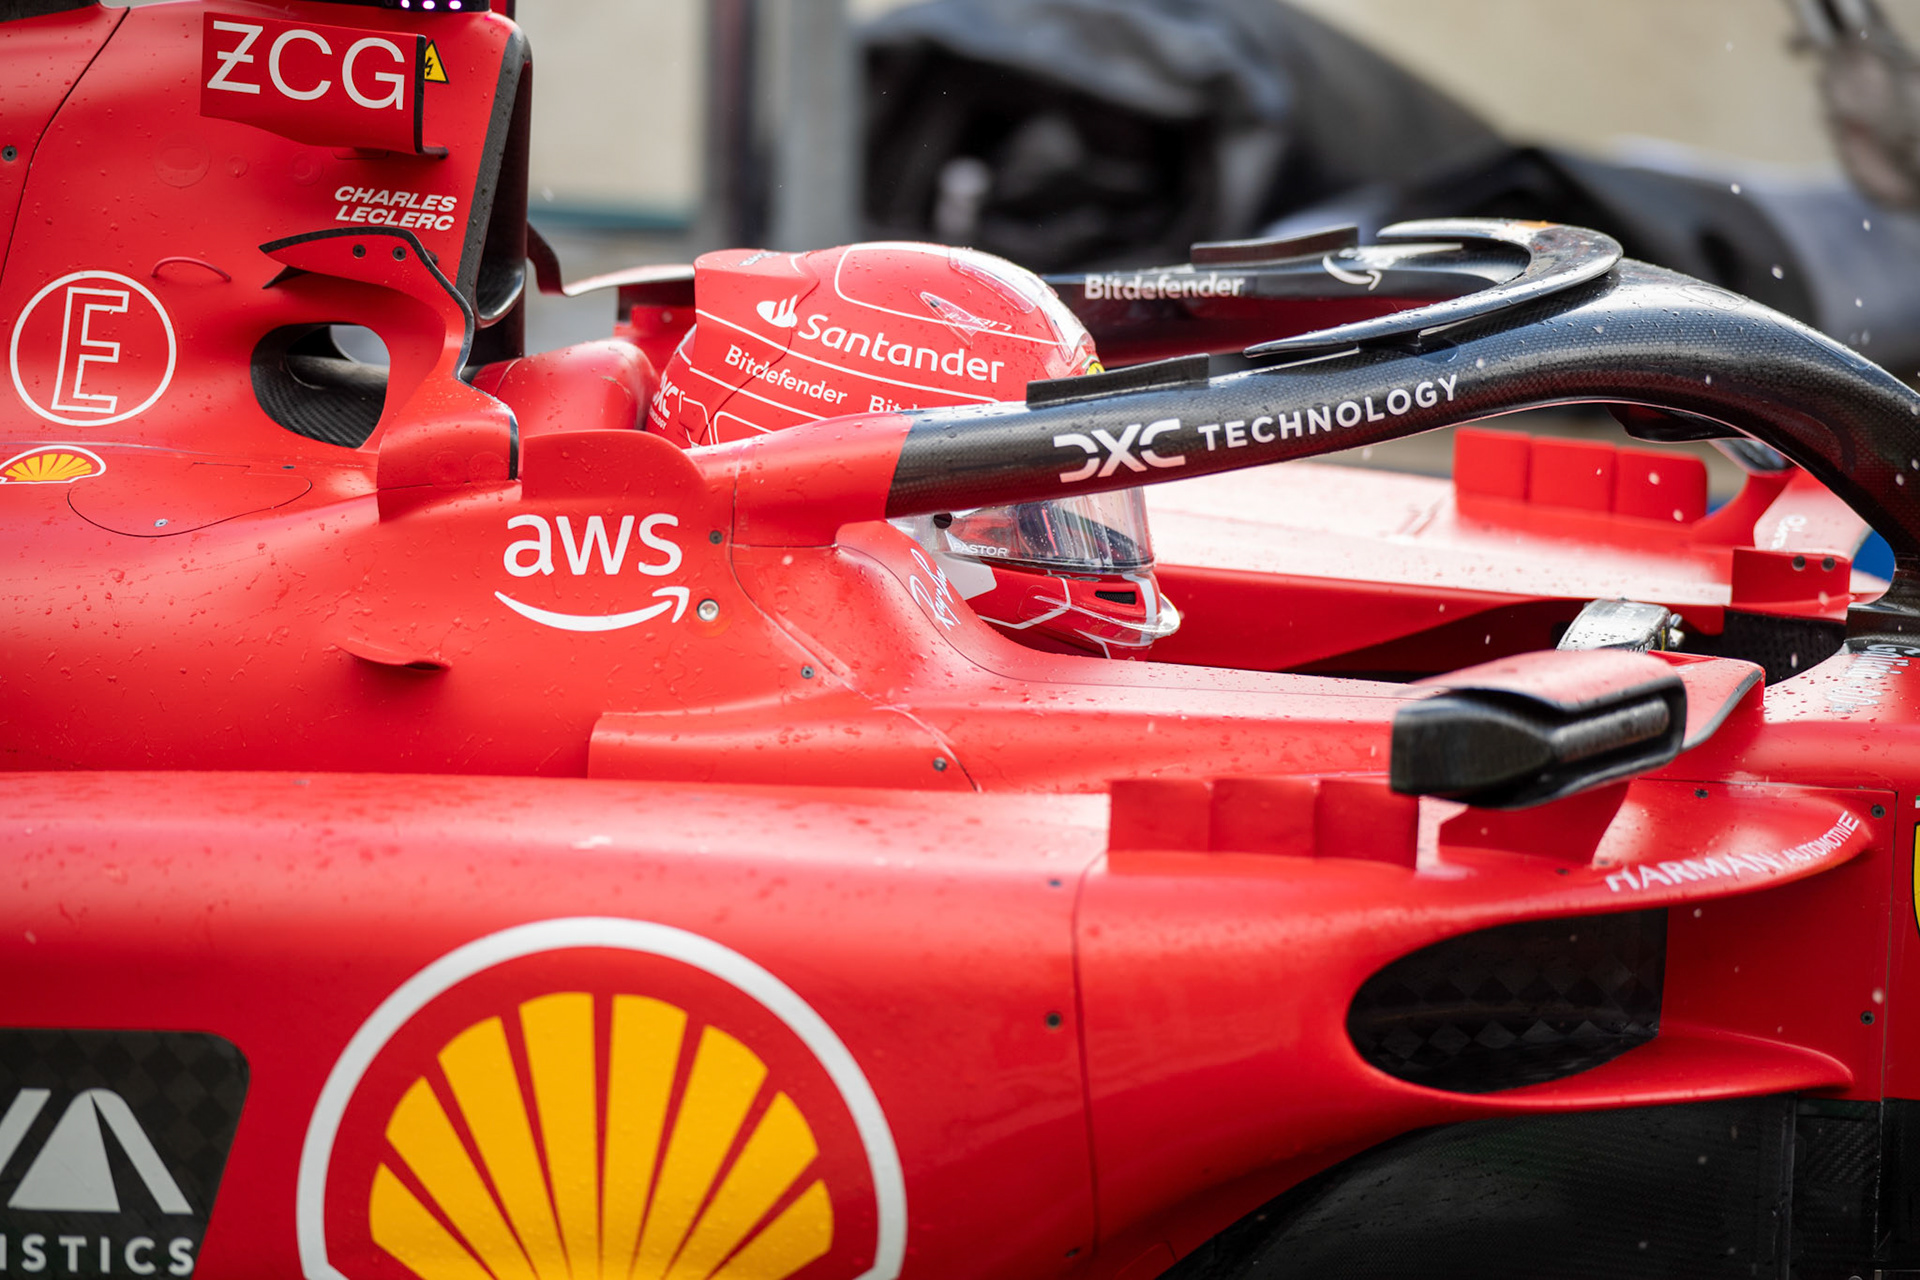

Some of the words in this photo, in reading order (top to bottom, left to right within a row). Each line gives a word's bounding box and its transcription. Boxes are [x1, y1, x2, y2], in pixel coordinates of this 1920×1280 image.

[334, 185, 458, 212] CHARLES
[335, 205, 455, 231] LECLERC
[1084, 271, 1245, 300] Bitdefender
[724, 344, 848, 405] Bitdefender
[797, 313, 1005, 384] Santander
[1053, 417, 1186, 483] DXC
[1197, 374, 1458, 451] TECHNOLOGY
[503, 513, 683, 577] aws
[1604, 852, 1783, 893] HARMAN
[1780, 810, 1860, 864] AUTOMOTIVE
